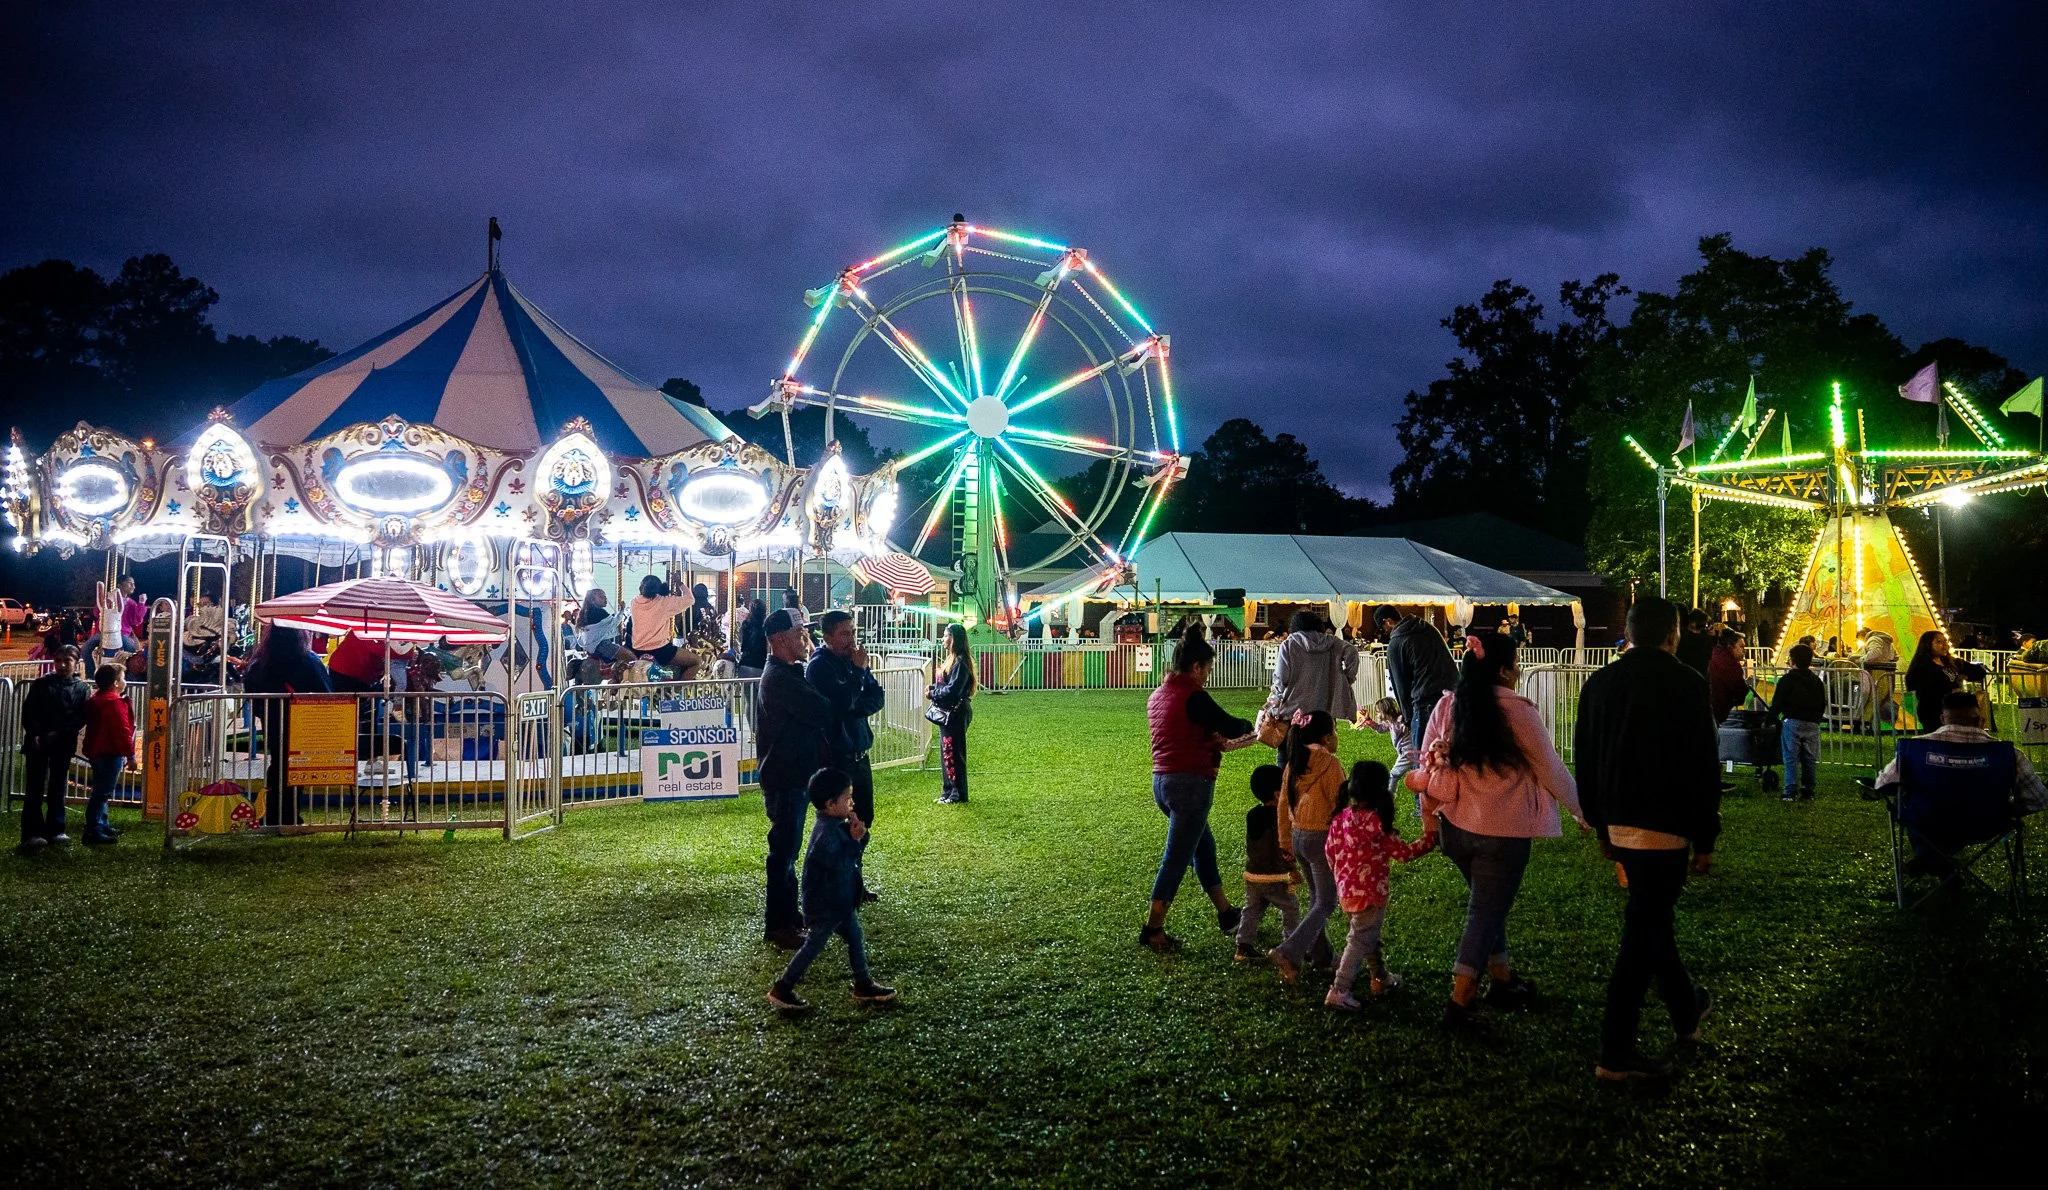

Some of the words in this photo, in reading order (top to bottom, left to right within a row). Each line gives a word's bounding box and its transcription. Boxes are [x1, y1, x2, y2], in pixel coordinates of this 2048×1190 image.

[156, 639, 166, 667] YES
[523, 698, 547, 717] EXIT
[679, 697, 723, 711] SPONSOR
[153, 708, 163, 732] WITH
[669, 728, 735, 745] SPONSOR
[657, 750, 722, 781] roi
[658, 781, 681, 792] real
[685, 780, 723, 791] estate
